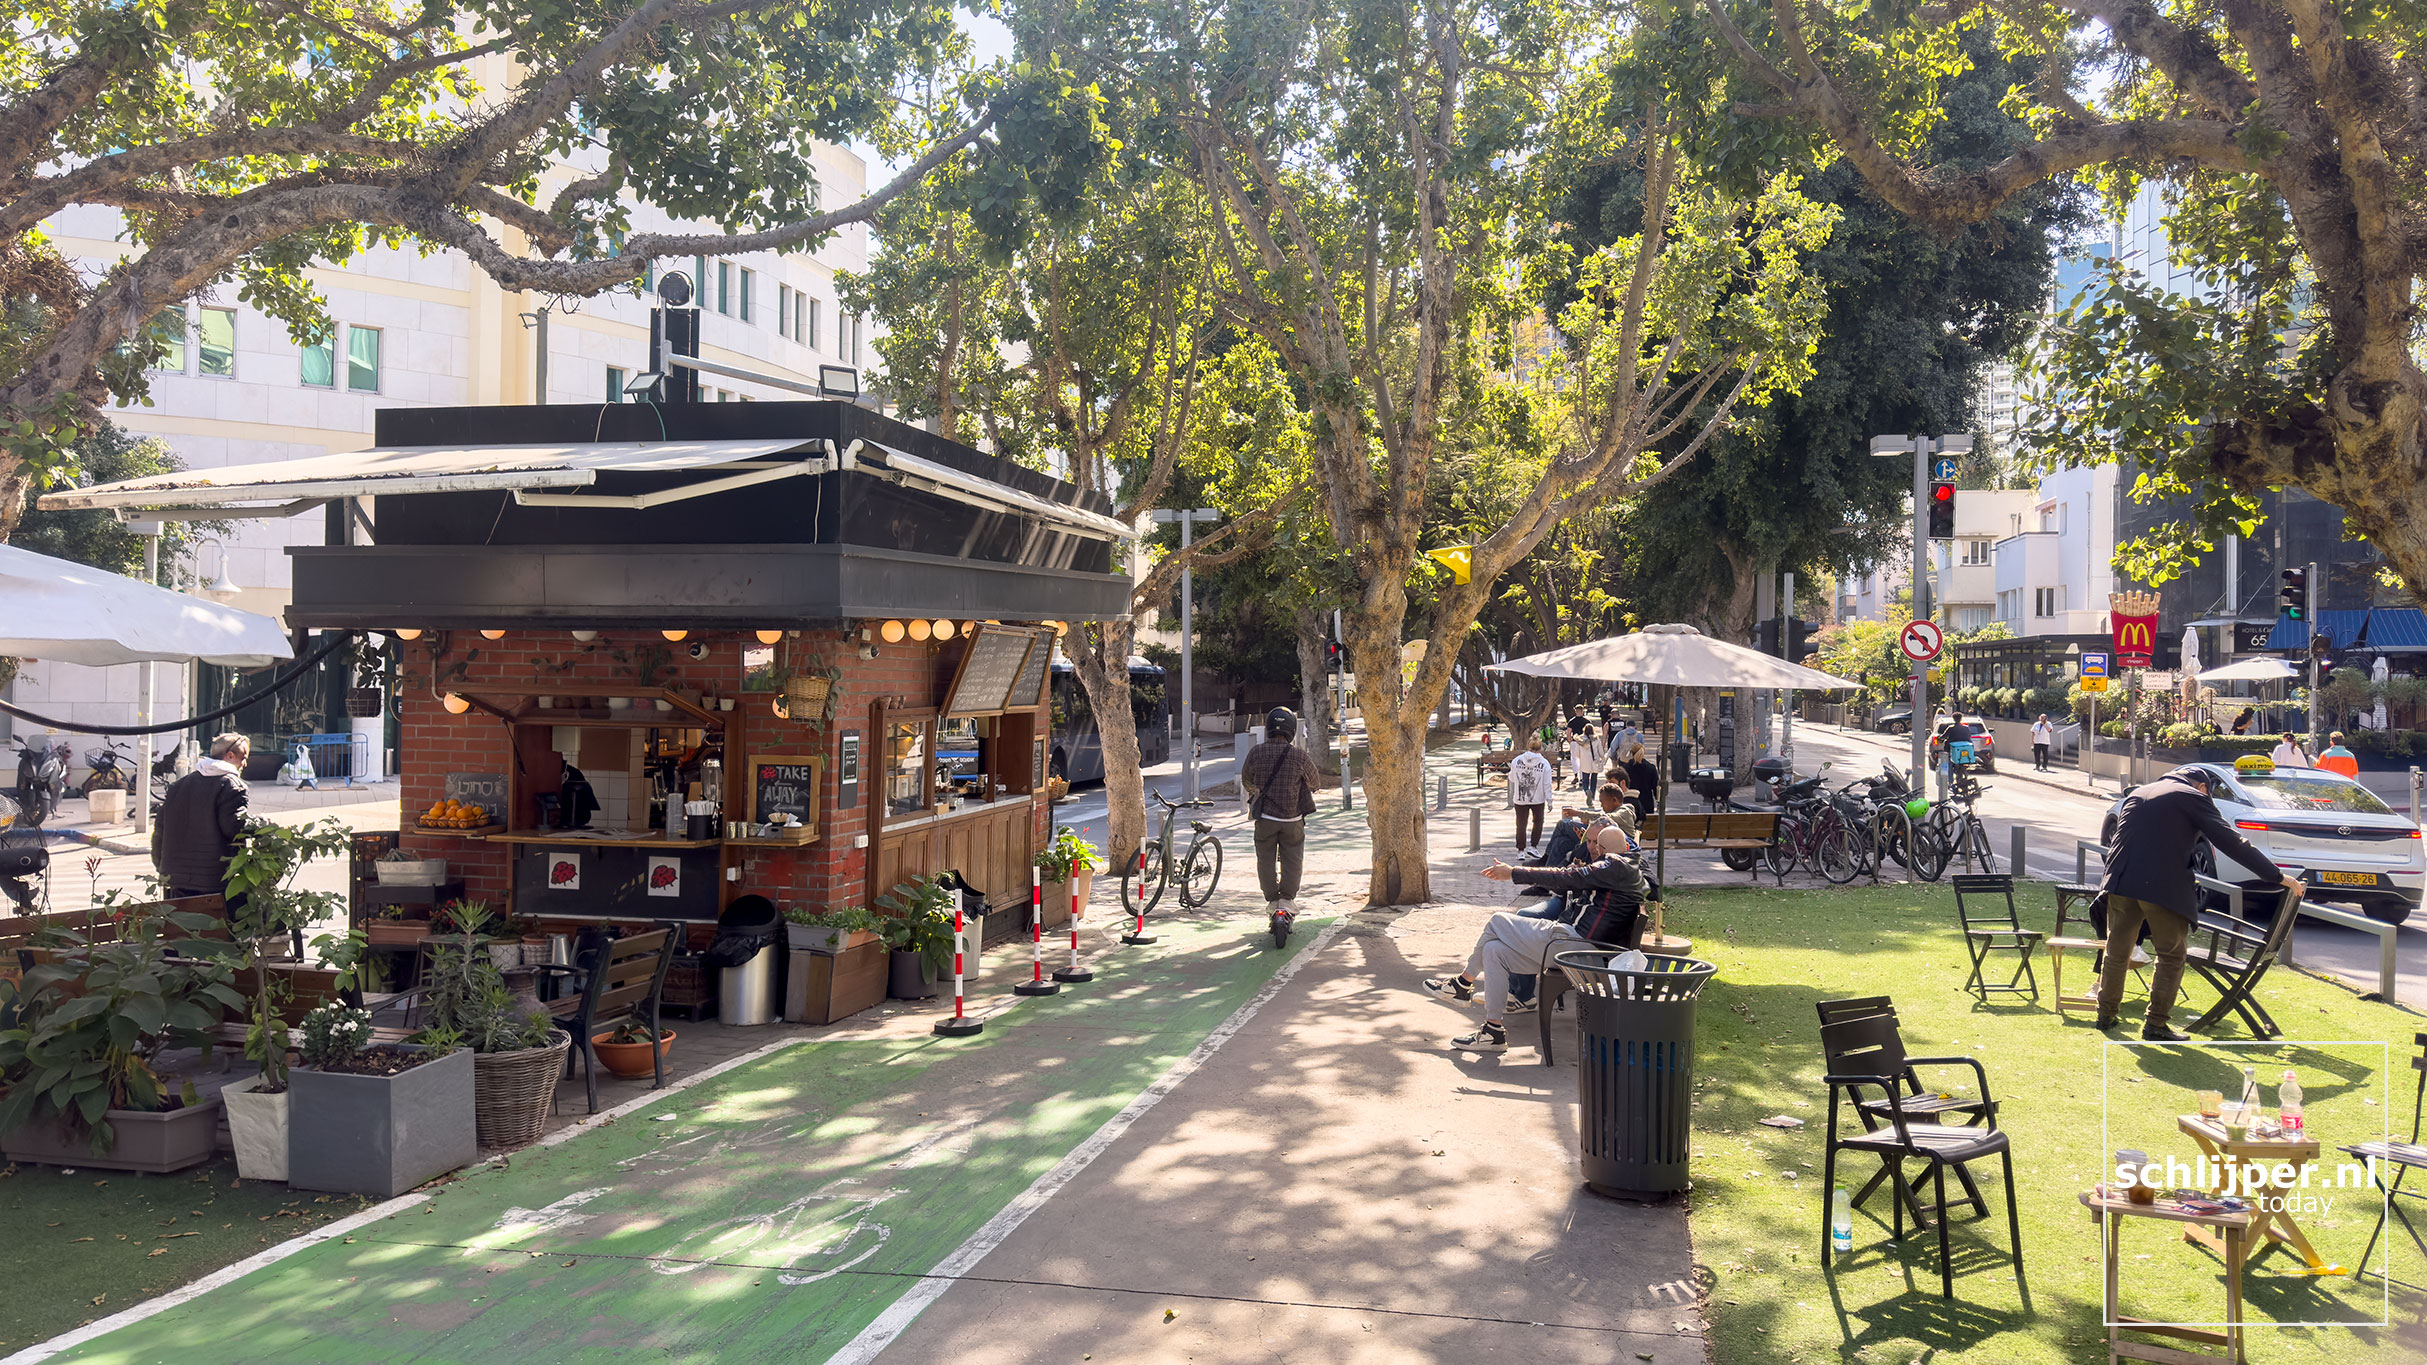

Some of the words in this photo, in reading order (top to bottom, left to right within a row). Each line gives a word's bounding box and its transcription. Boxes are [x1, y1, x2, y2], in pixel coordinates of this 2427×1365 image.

[2250, 634, 2268, 647] 65
[776, 766, 808, 780] TAKE
[763, 785, 798, 805] AWAY
